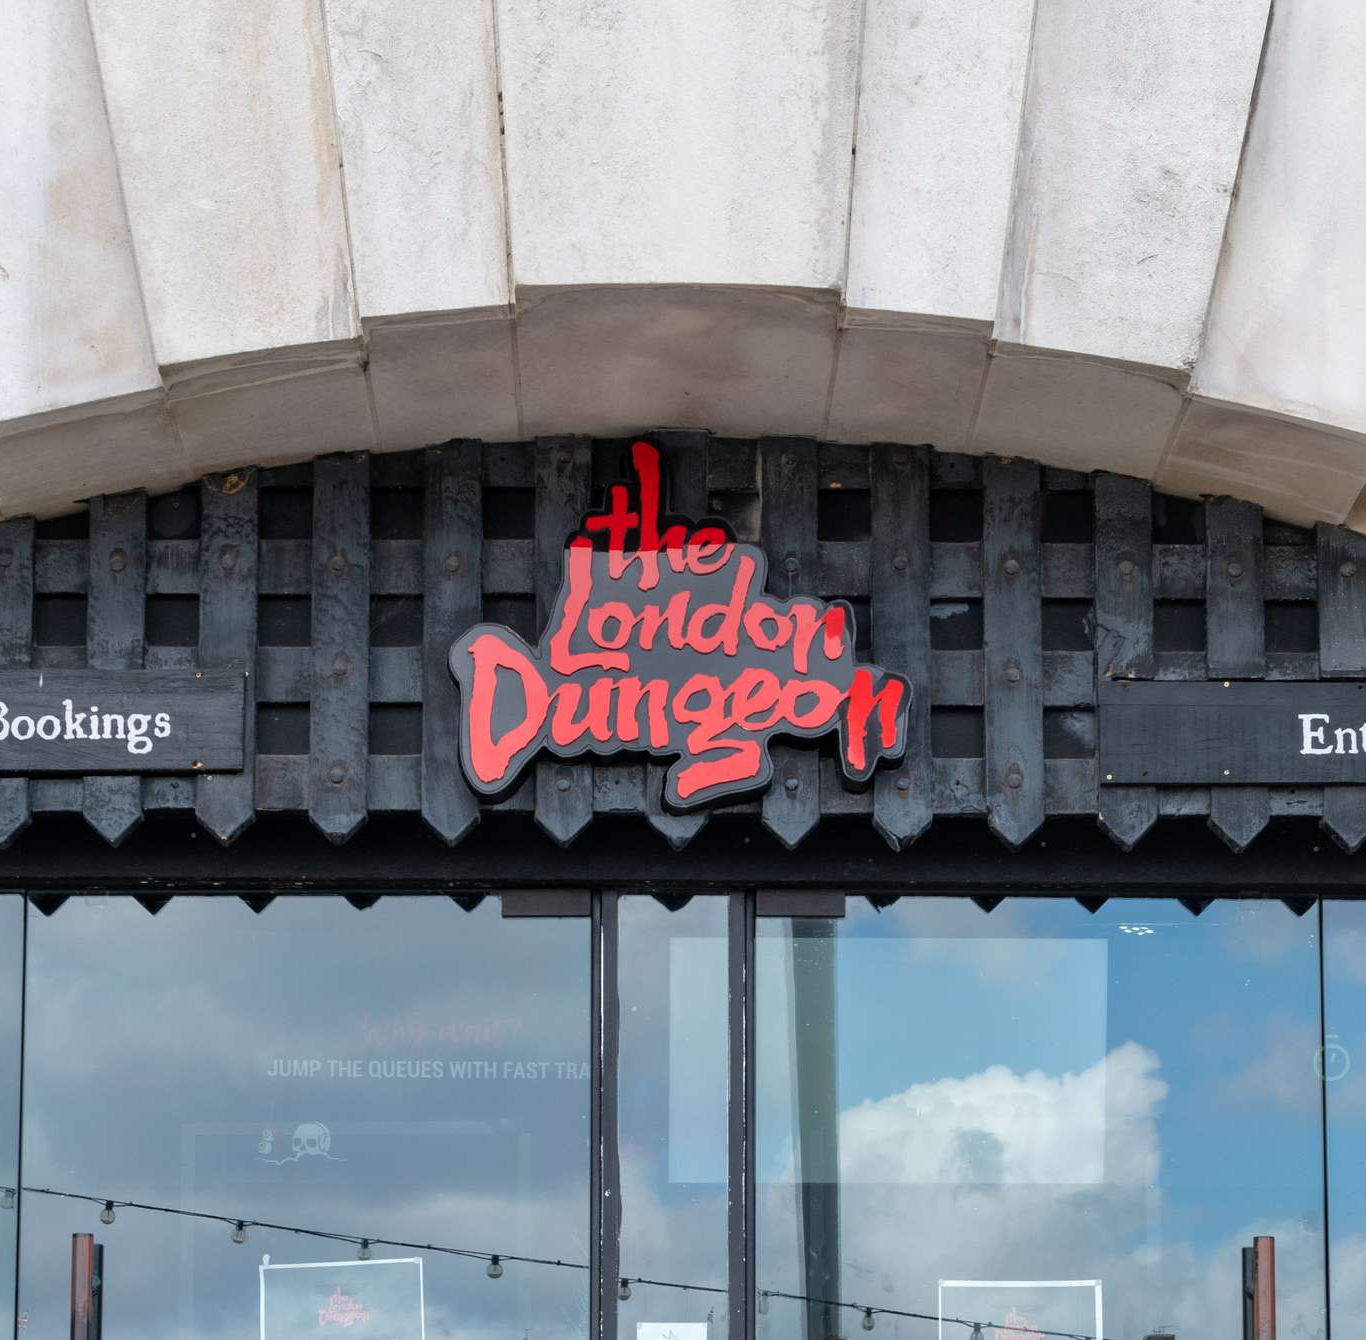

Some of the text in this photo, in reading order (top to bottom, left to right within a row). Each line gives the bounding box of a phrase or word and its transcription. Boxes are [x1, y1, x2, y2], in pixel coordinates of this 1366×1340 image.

[584, 441, 734, 592] the
[548, 536, 847, 676] London
[467, 633, 905, 801] Dungeon
[266, 1059, 323, 1078] JUMP
[326, 1059, 364, 1078] THE
[368, 1060, 444, 1079] QUEUES
[449, 1061, 498, 1080] WITH
[502, 1061, 550, 1080] FAST
